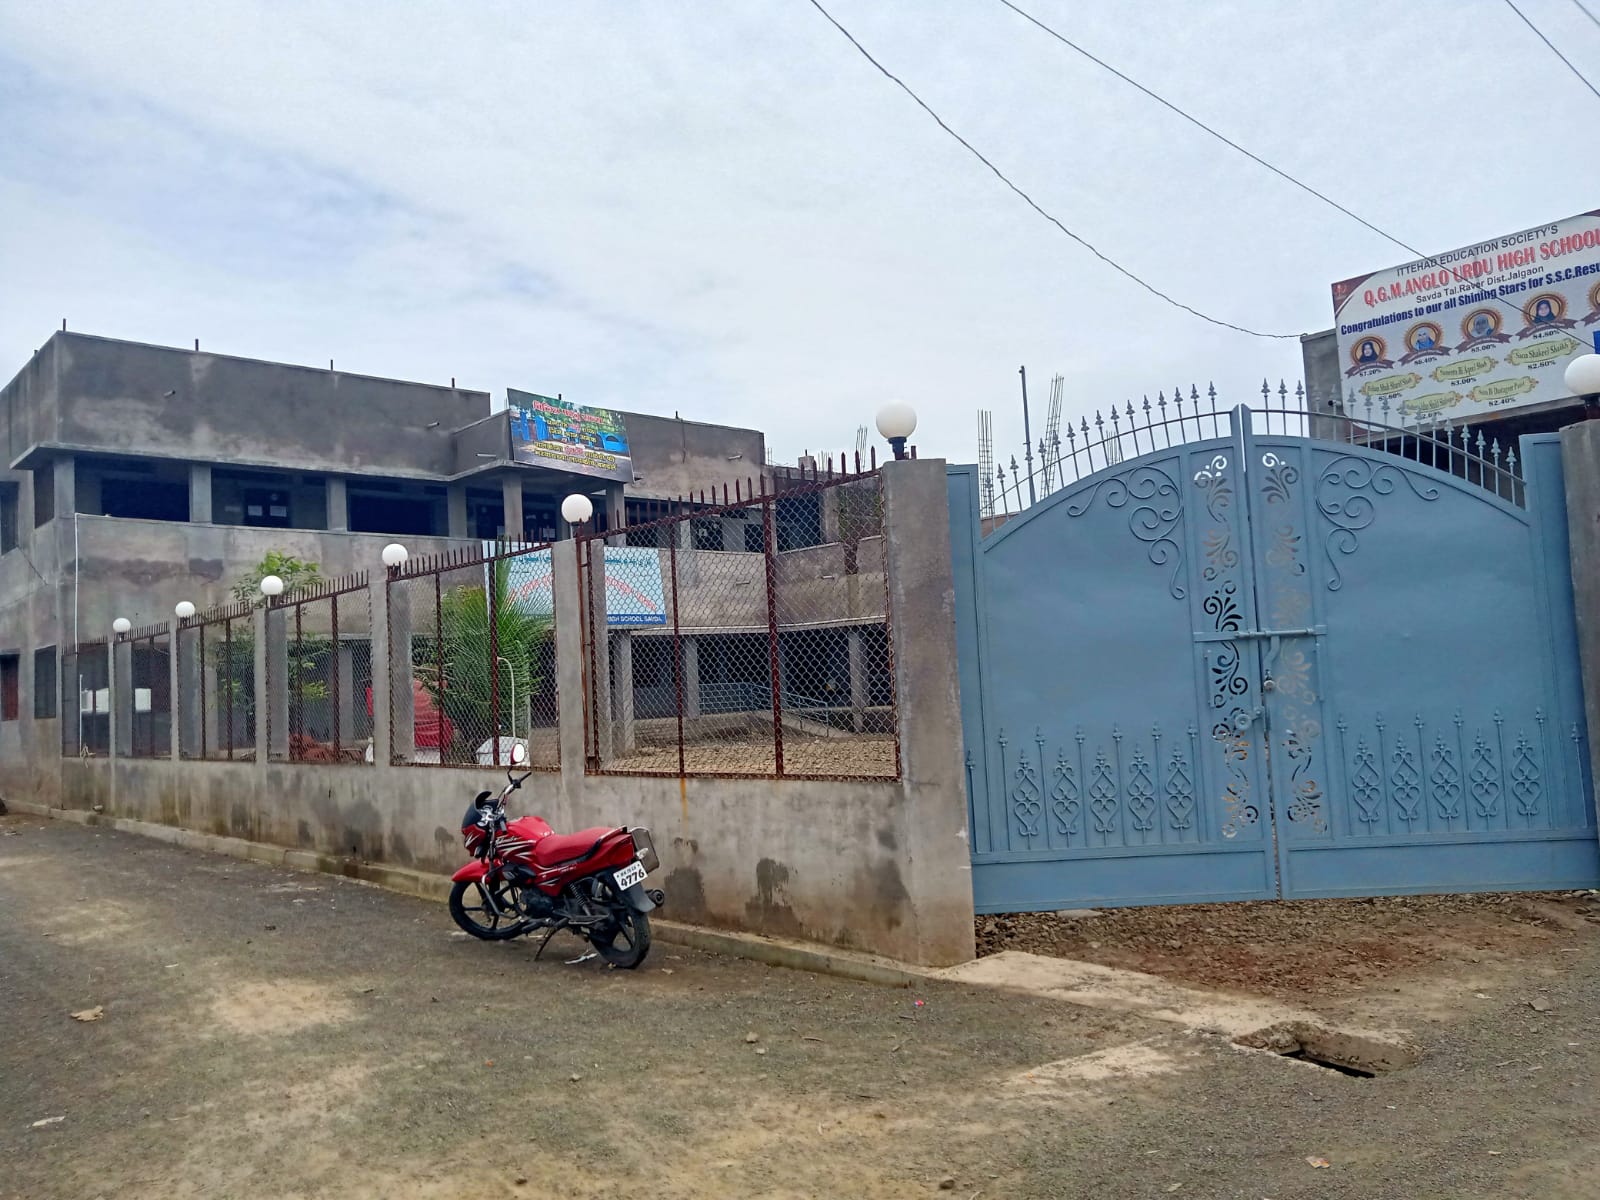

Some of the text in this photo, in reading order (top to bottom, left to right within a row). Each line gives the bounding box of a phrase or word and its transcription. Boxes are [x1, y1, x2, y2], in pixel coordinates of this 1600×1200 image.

[1364, 269, 1450, 308] Q.G.M.ANGLO
[1453, 257, 1494, 284] URDU
[1497, 246, 1536, 272] HIGH
[1397, 224, 1558, 277] ITTEHAD EDUCATION SOCIETY'S
[1341, 310, 1413, 335] Congratulations
[1415, 307, 1424, 317] to
[1426, 303, 1442, 314] our
[1444, 297, 1457, 310] all
[1459, 287, 1497, 306] Shining
[1498, 281, 1527, 297] Stars
[1528, 276, 1543, 290] for
[1416, 290, 1442, 304] Savda
[1487, 265, 1544, 286] Dist.Jalgaon
[620, 869, 645, 887] 4776
